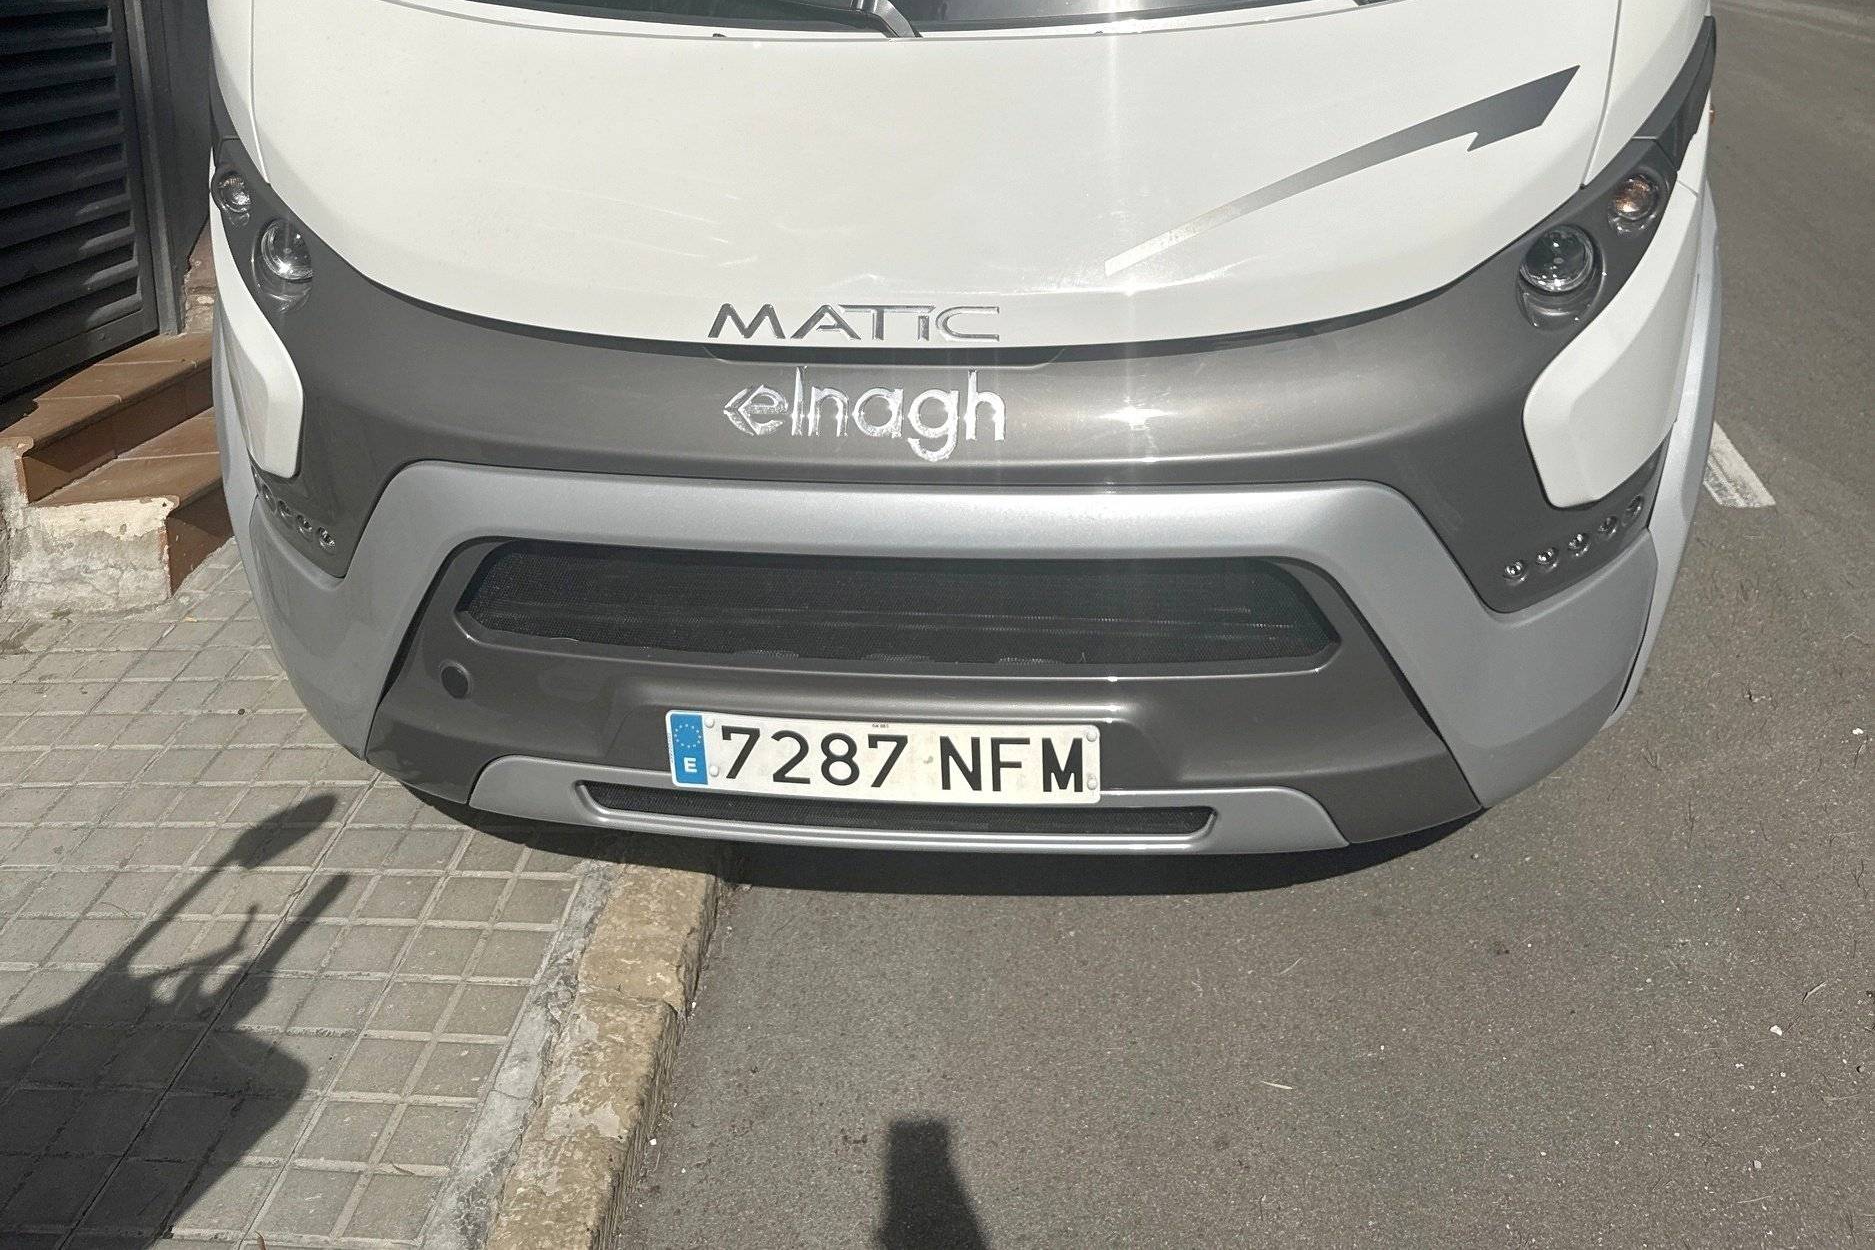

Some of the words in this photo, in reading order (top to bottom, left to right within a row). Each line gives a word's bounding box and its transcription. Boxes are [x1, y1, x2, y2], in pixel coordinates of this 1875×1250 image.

[723, 365, 1006, 462] elnagh
[683, 756, 698, 773] E
[721, 725, 908, 788] 7287
[939, 735, 1086, 792] NFM
